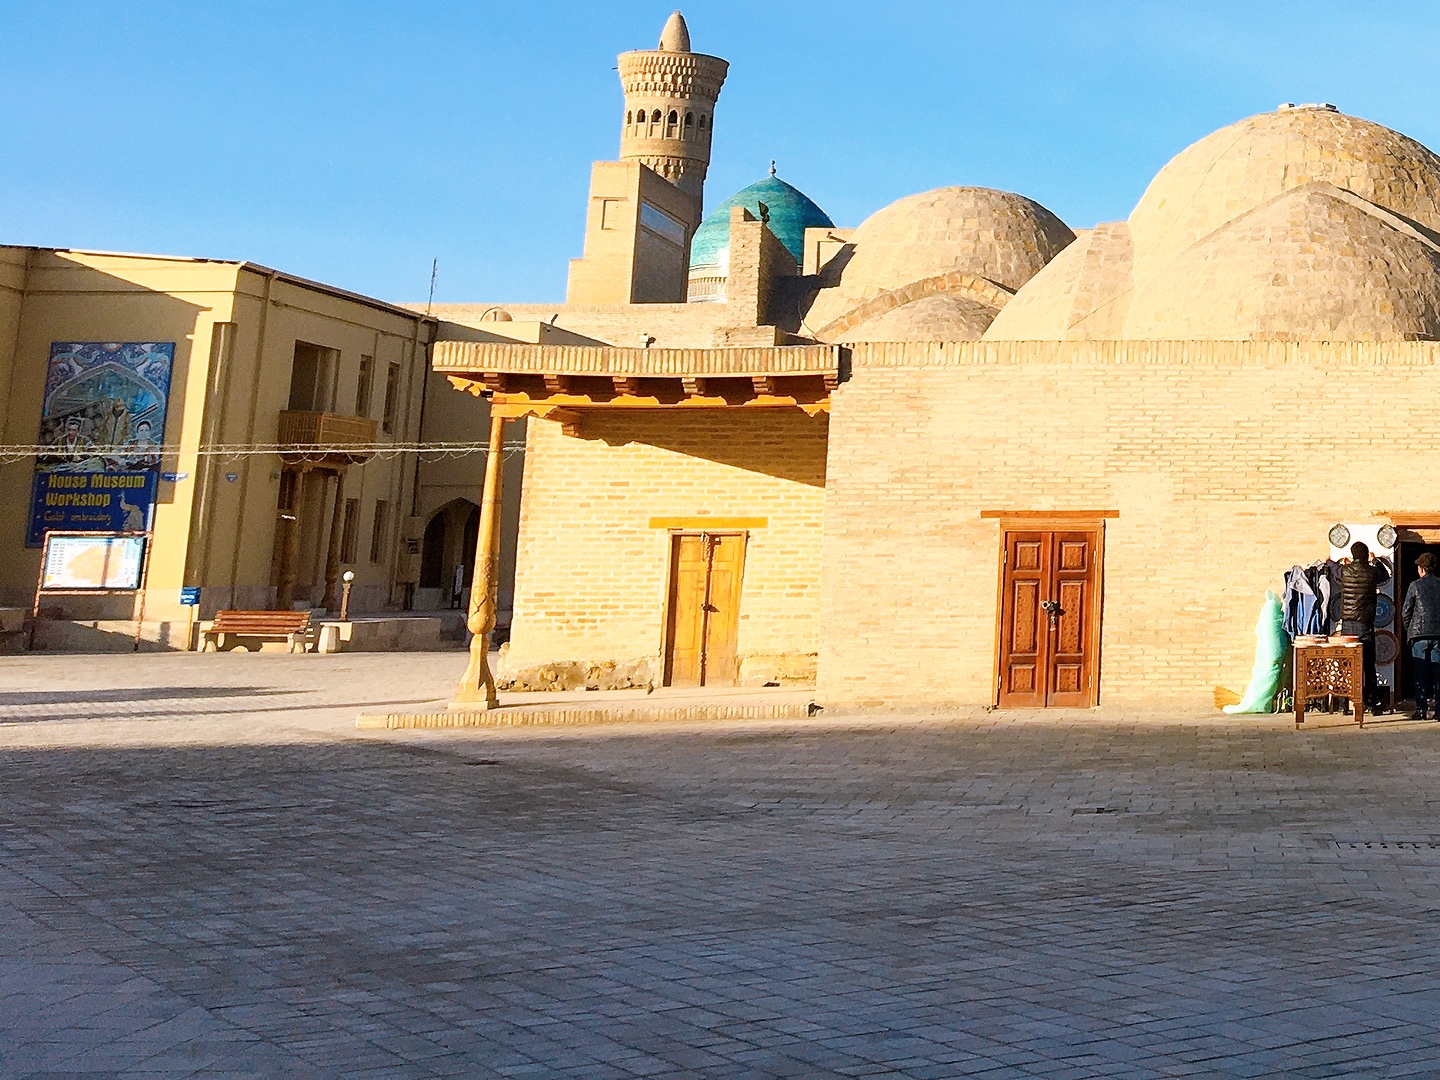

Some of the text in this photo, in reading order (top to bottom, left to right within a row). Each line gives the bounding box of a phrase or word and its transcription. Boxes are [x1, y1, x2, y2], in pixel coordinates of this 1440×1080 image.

[48, 474, 87, 488] House
[91, 474, 146, 488] Museum
[46, 493, 111, 507] Workshop
